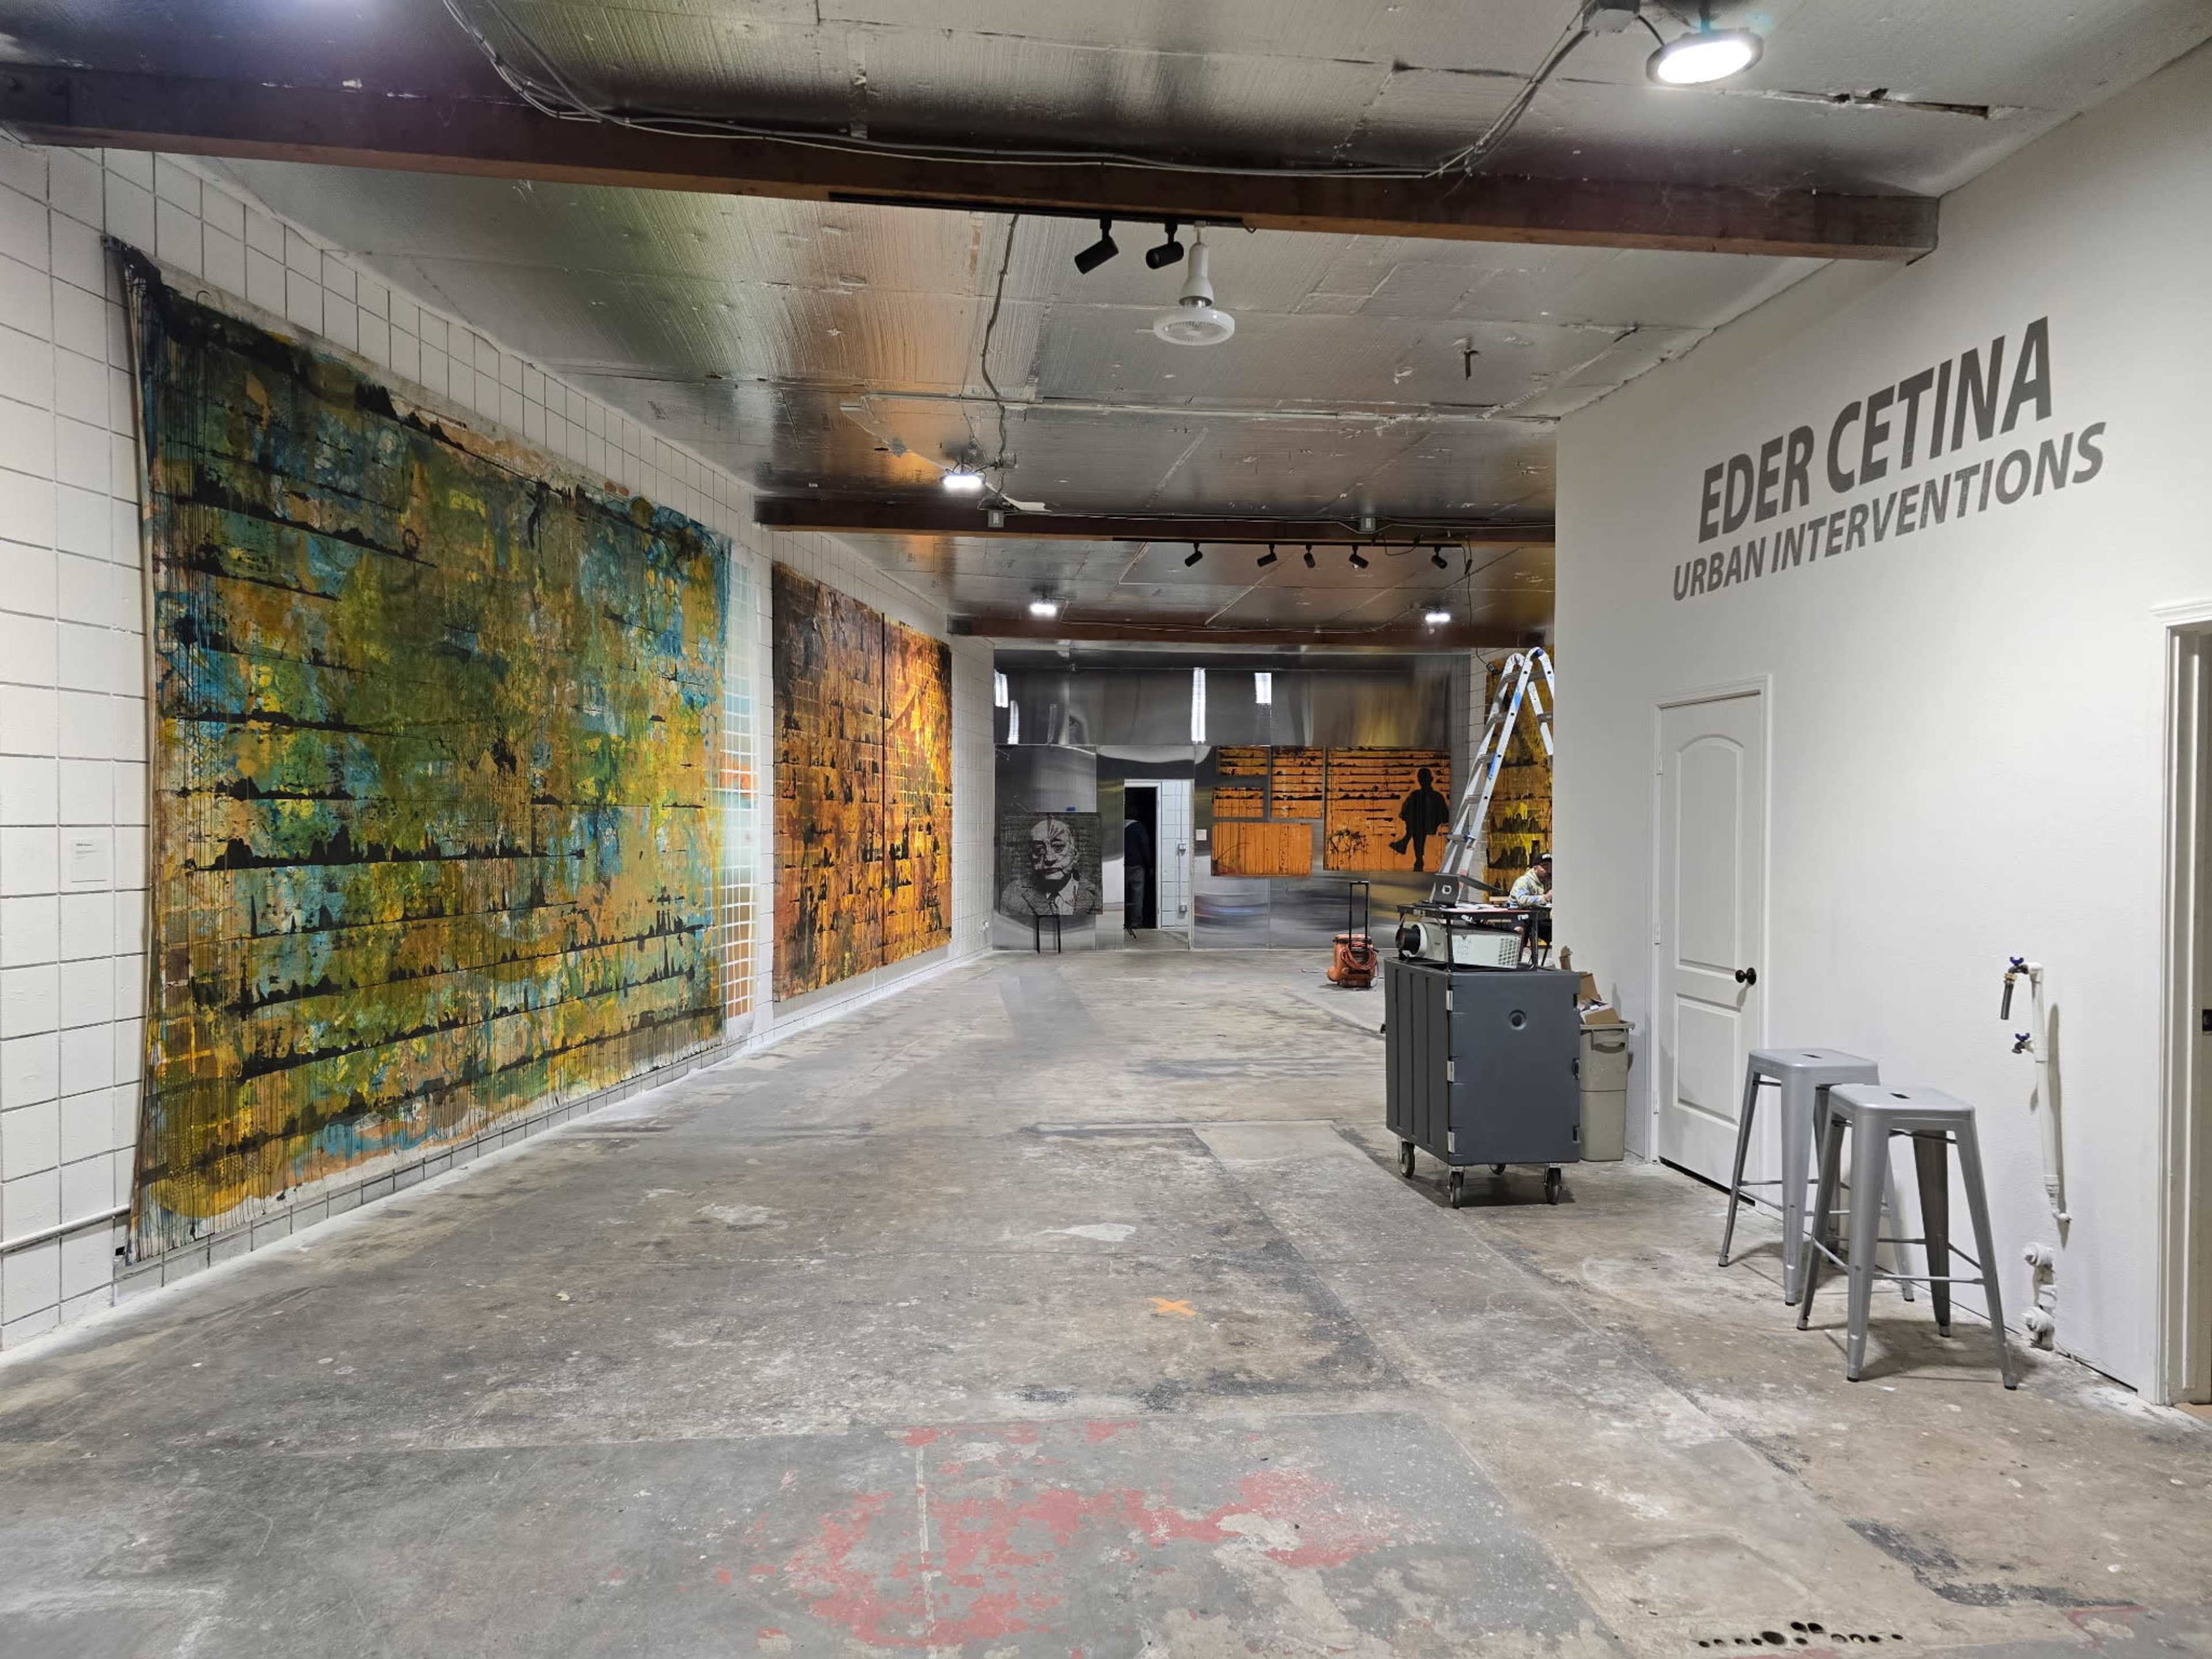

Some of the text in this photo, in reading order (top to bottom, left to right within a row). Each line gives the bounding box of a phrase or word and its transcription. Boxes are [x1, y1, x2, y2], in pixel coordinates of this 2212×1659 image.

[1673, 422, 2107, 601] URBAN INTERVENTIONS
[1698, 316, 2052, 544] EDER CETINA
